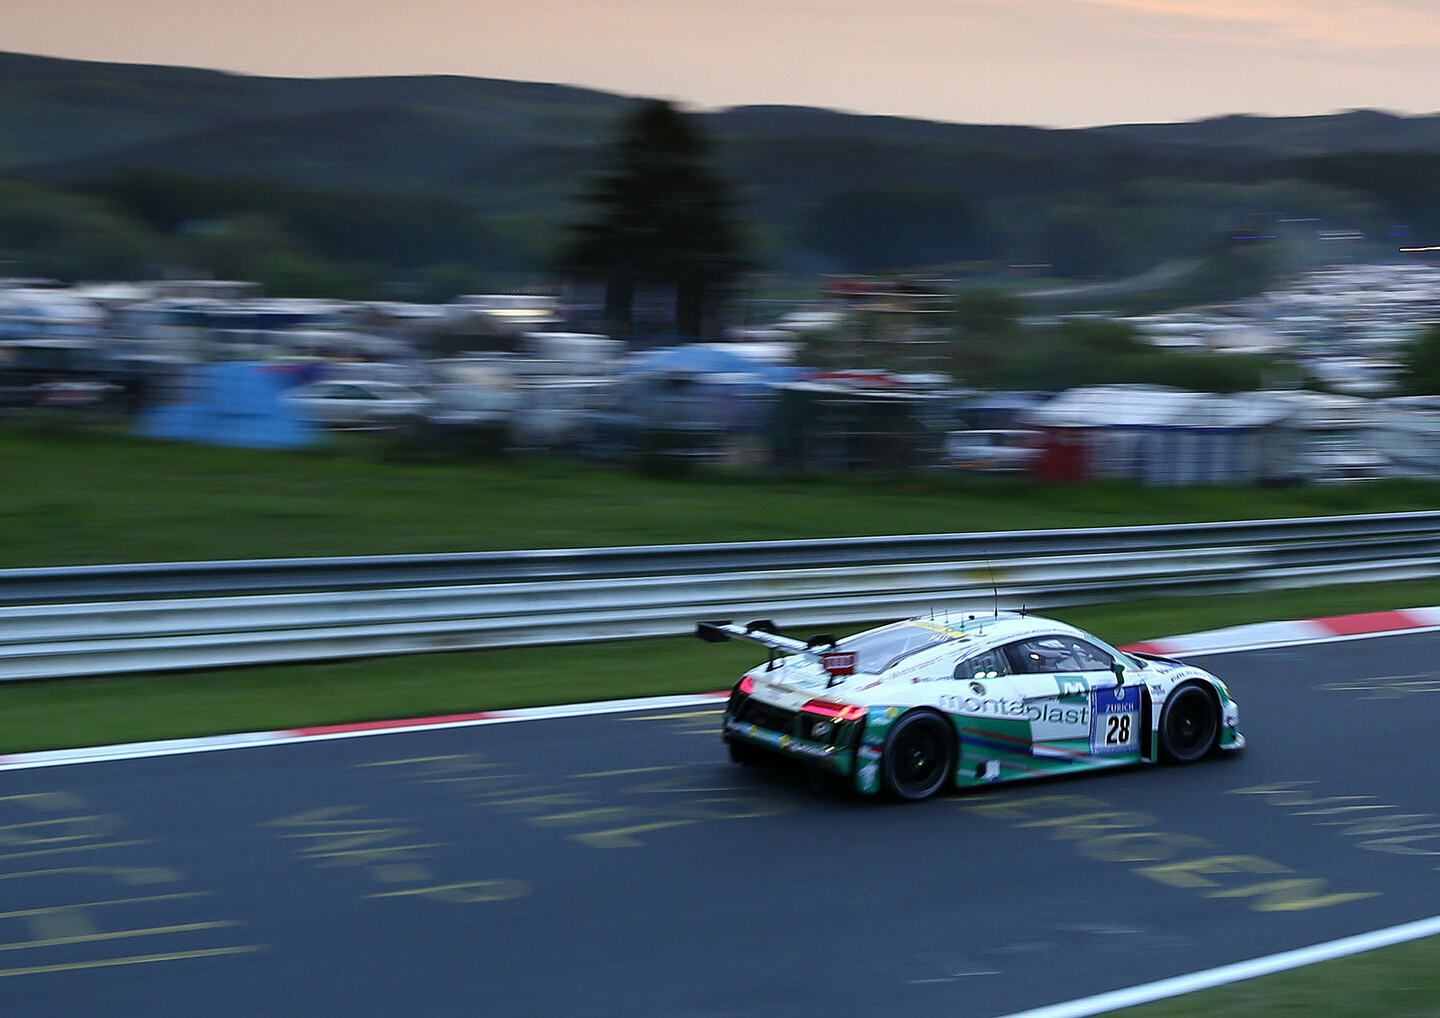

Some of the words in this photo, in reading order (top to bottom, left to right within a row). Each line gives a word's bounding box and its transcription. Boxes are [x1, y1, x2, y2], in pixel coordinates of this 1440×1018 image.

[937, 693, 1089, 726] montaplast
[1105, 702, 1134, 714] ZURICH
[1106, 715, 1131, 745] 28
